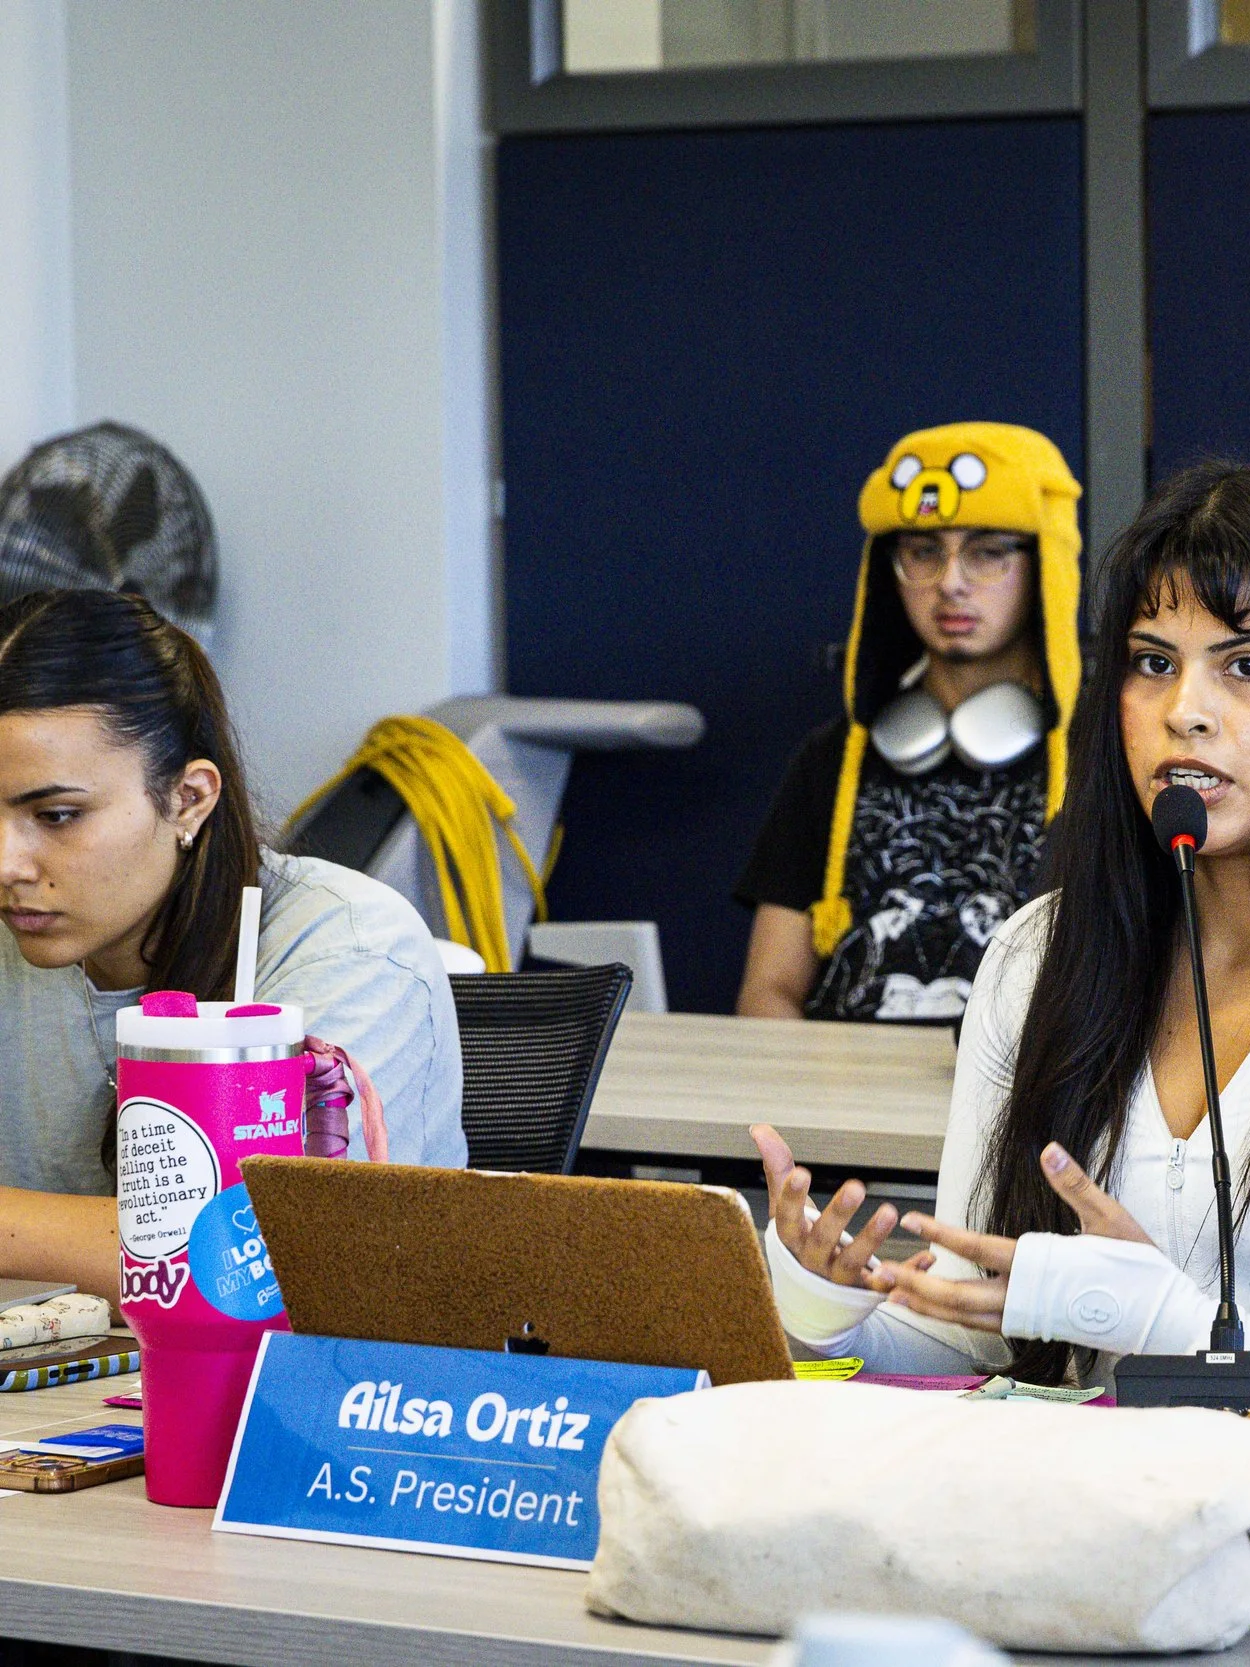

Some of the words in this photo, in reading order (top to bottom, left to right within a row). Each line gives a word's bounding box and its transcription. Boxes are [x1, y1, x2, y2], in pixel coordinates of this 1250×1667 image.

[131, 1129, 138, 1140] a
[141, 1123, 176, 1138] time
[233, 1119, 299, 1140] STANLEY
[120, 1144, 129, 1159] of
[131, 1138, 176, 1157] deceit
[159, 1155, 188, 1169] the
[122, 1176, 150, 1193] truth
[154, 1174, 170, 1187] is
[175, 1173, 185, 1184] a
[157, 1227, 187, 1239] Orwell
[338, 1380, 453, 1438] Ailsa
[465, 1392, 590, 1451] Ortiz
[306, 1462, 376, 1504] A.S.
[389, 1469, 583, 1526] President
